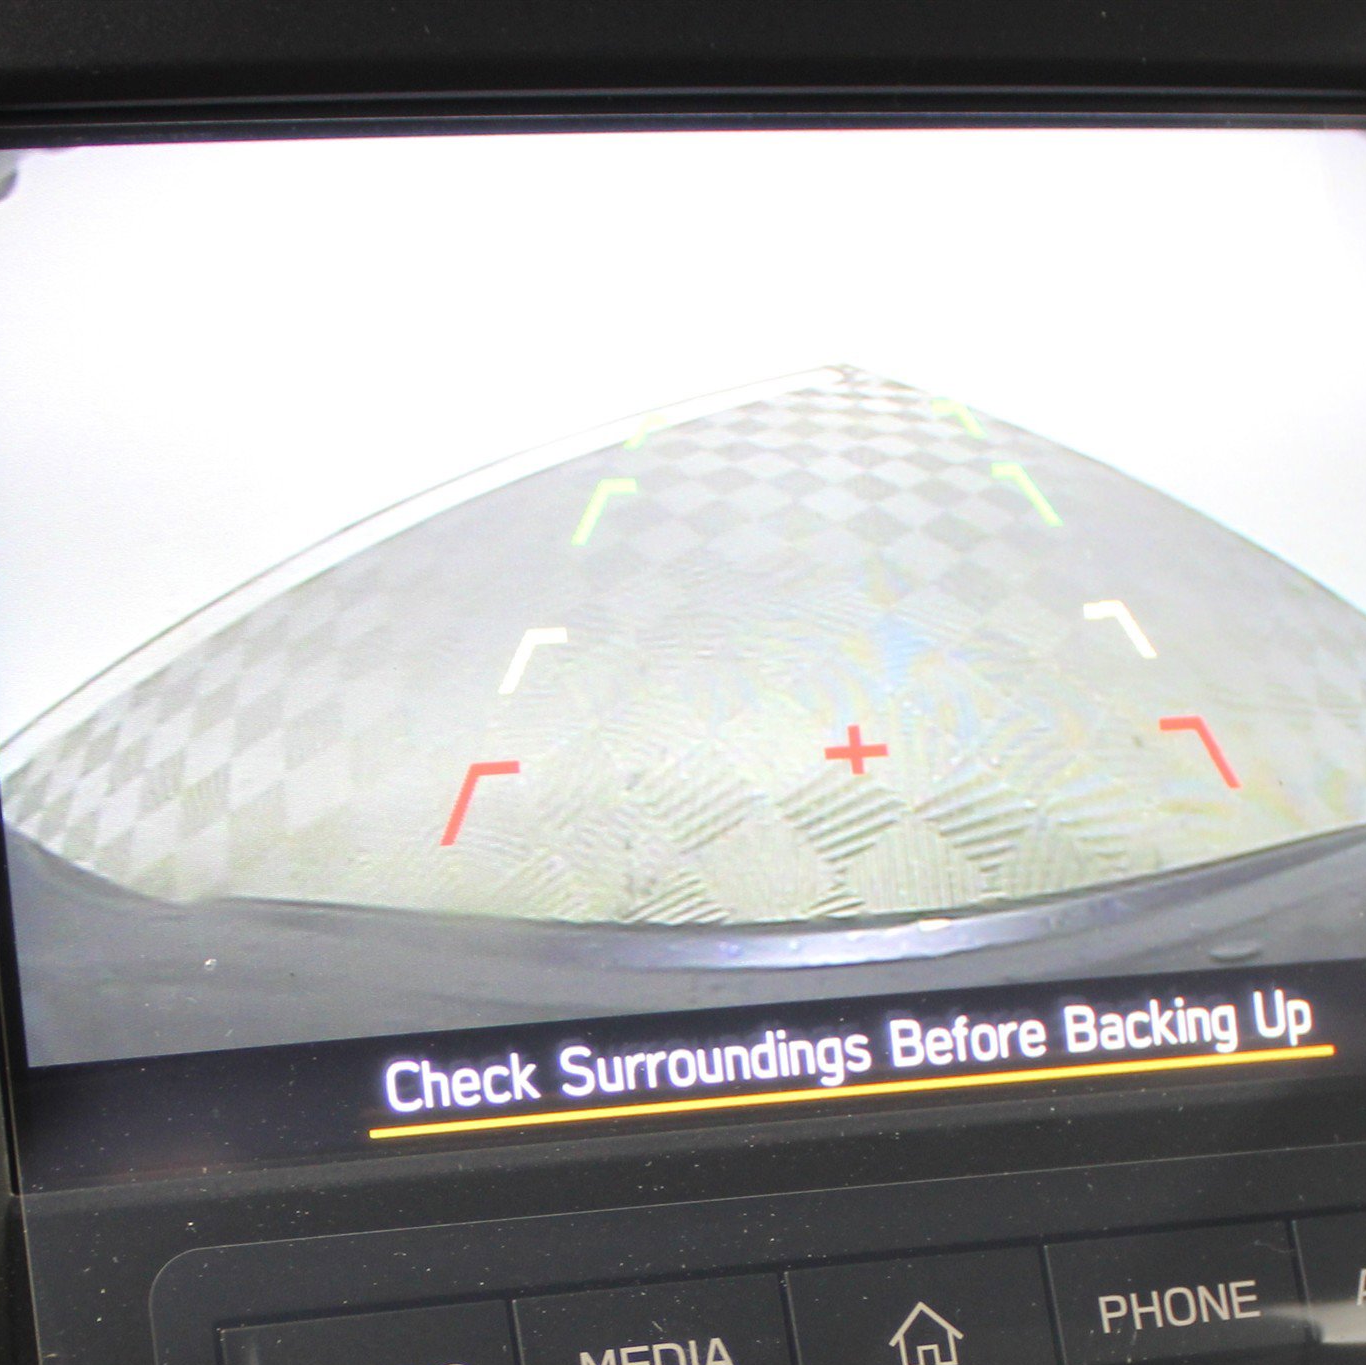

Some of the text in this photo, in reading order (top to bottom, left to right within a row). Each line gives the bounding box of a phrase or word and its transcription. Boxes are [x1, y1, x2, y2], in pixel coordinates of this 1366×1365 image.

[383, 988, 1314, 1116] Check Surroundings Before Backing Up
[1096, 1278, 1262, 1335] PHONE
